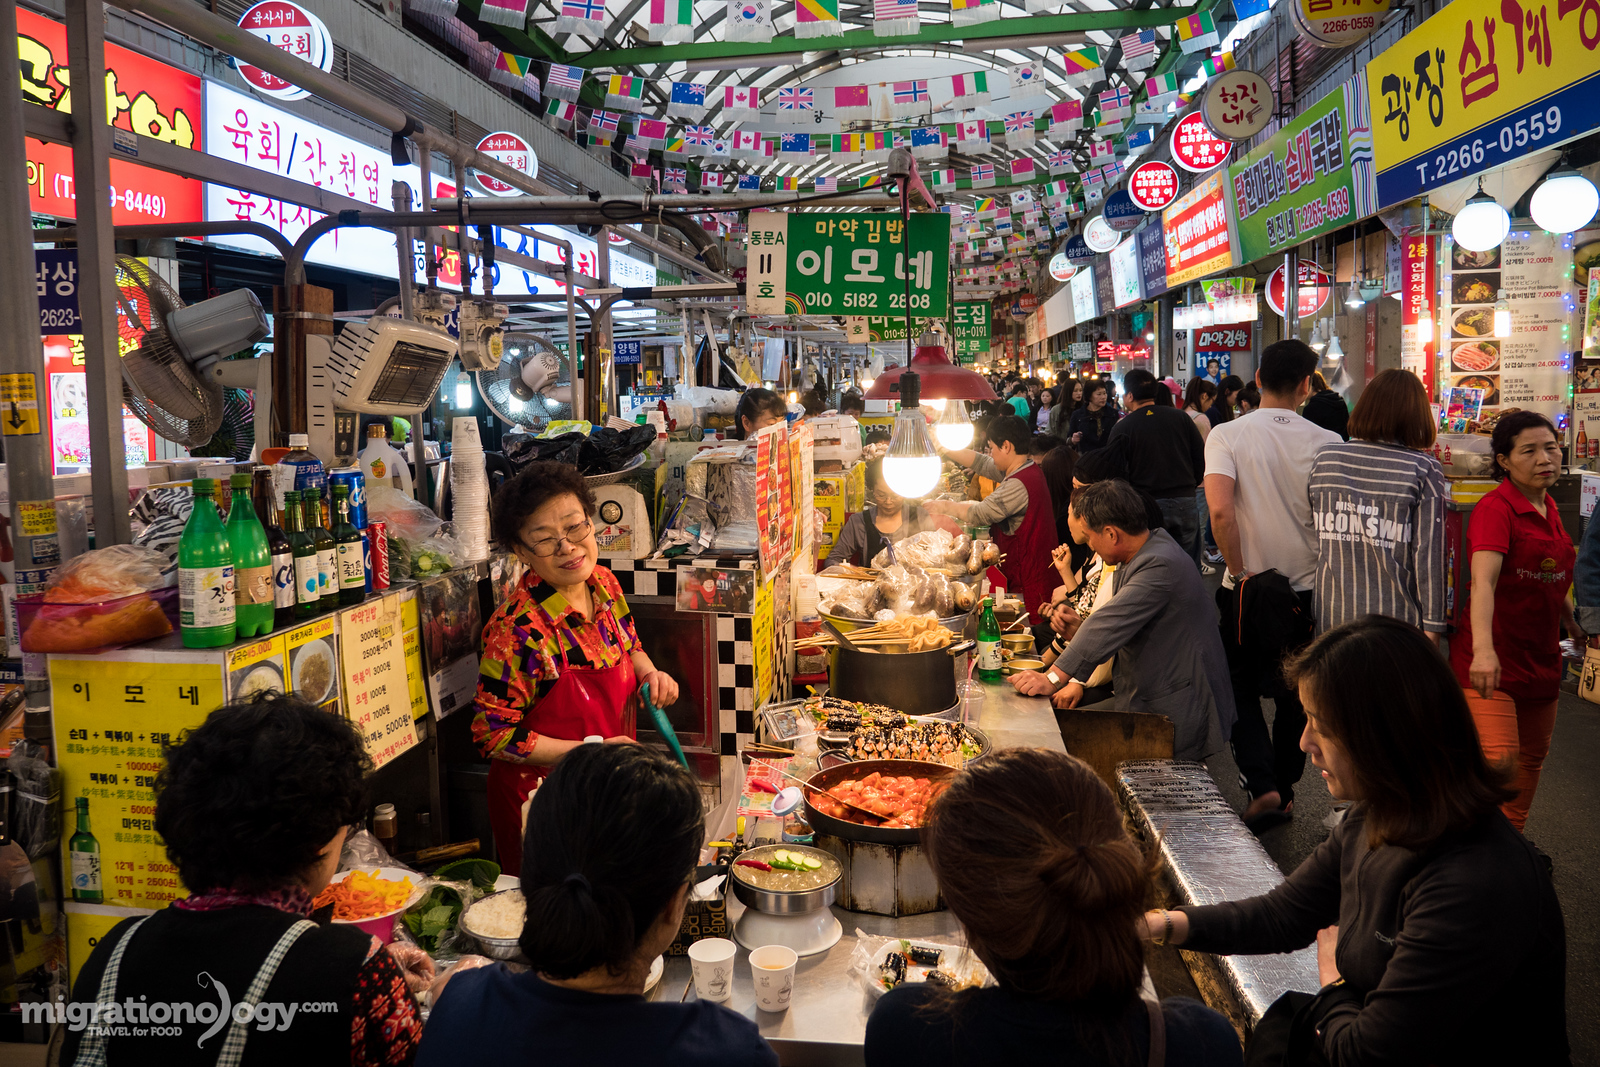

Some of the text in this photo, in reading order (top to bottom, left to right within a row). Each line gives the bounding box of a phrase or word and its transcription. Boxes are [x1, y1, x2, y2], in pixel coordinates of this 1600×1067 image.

[252, 9, 295, 26] 육사시미
[1322, 16, 1375, 34] 2266-0559
[1381, 47, 1446, 142] 광장
[1416, 105, 1562, 185] T.2266-0559
[1266, 207, 1296, 248] 현진네
[1296, 185, 1350, 233] T.2265-4539
[750, 231, 785, 245] 동문A
[815, 219, 904, 243] 마약김밥
[796, 245, 933, 290] 이모네
[756, 281, 775, 298] 호
[805, 292, 930, 309] 010 5182 2808
[852, 325, 863, 335] 호
[1198, 329, 1248, 348] 마약김밥
[90, 772, 118, 785] 떡볶이
